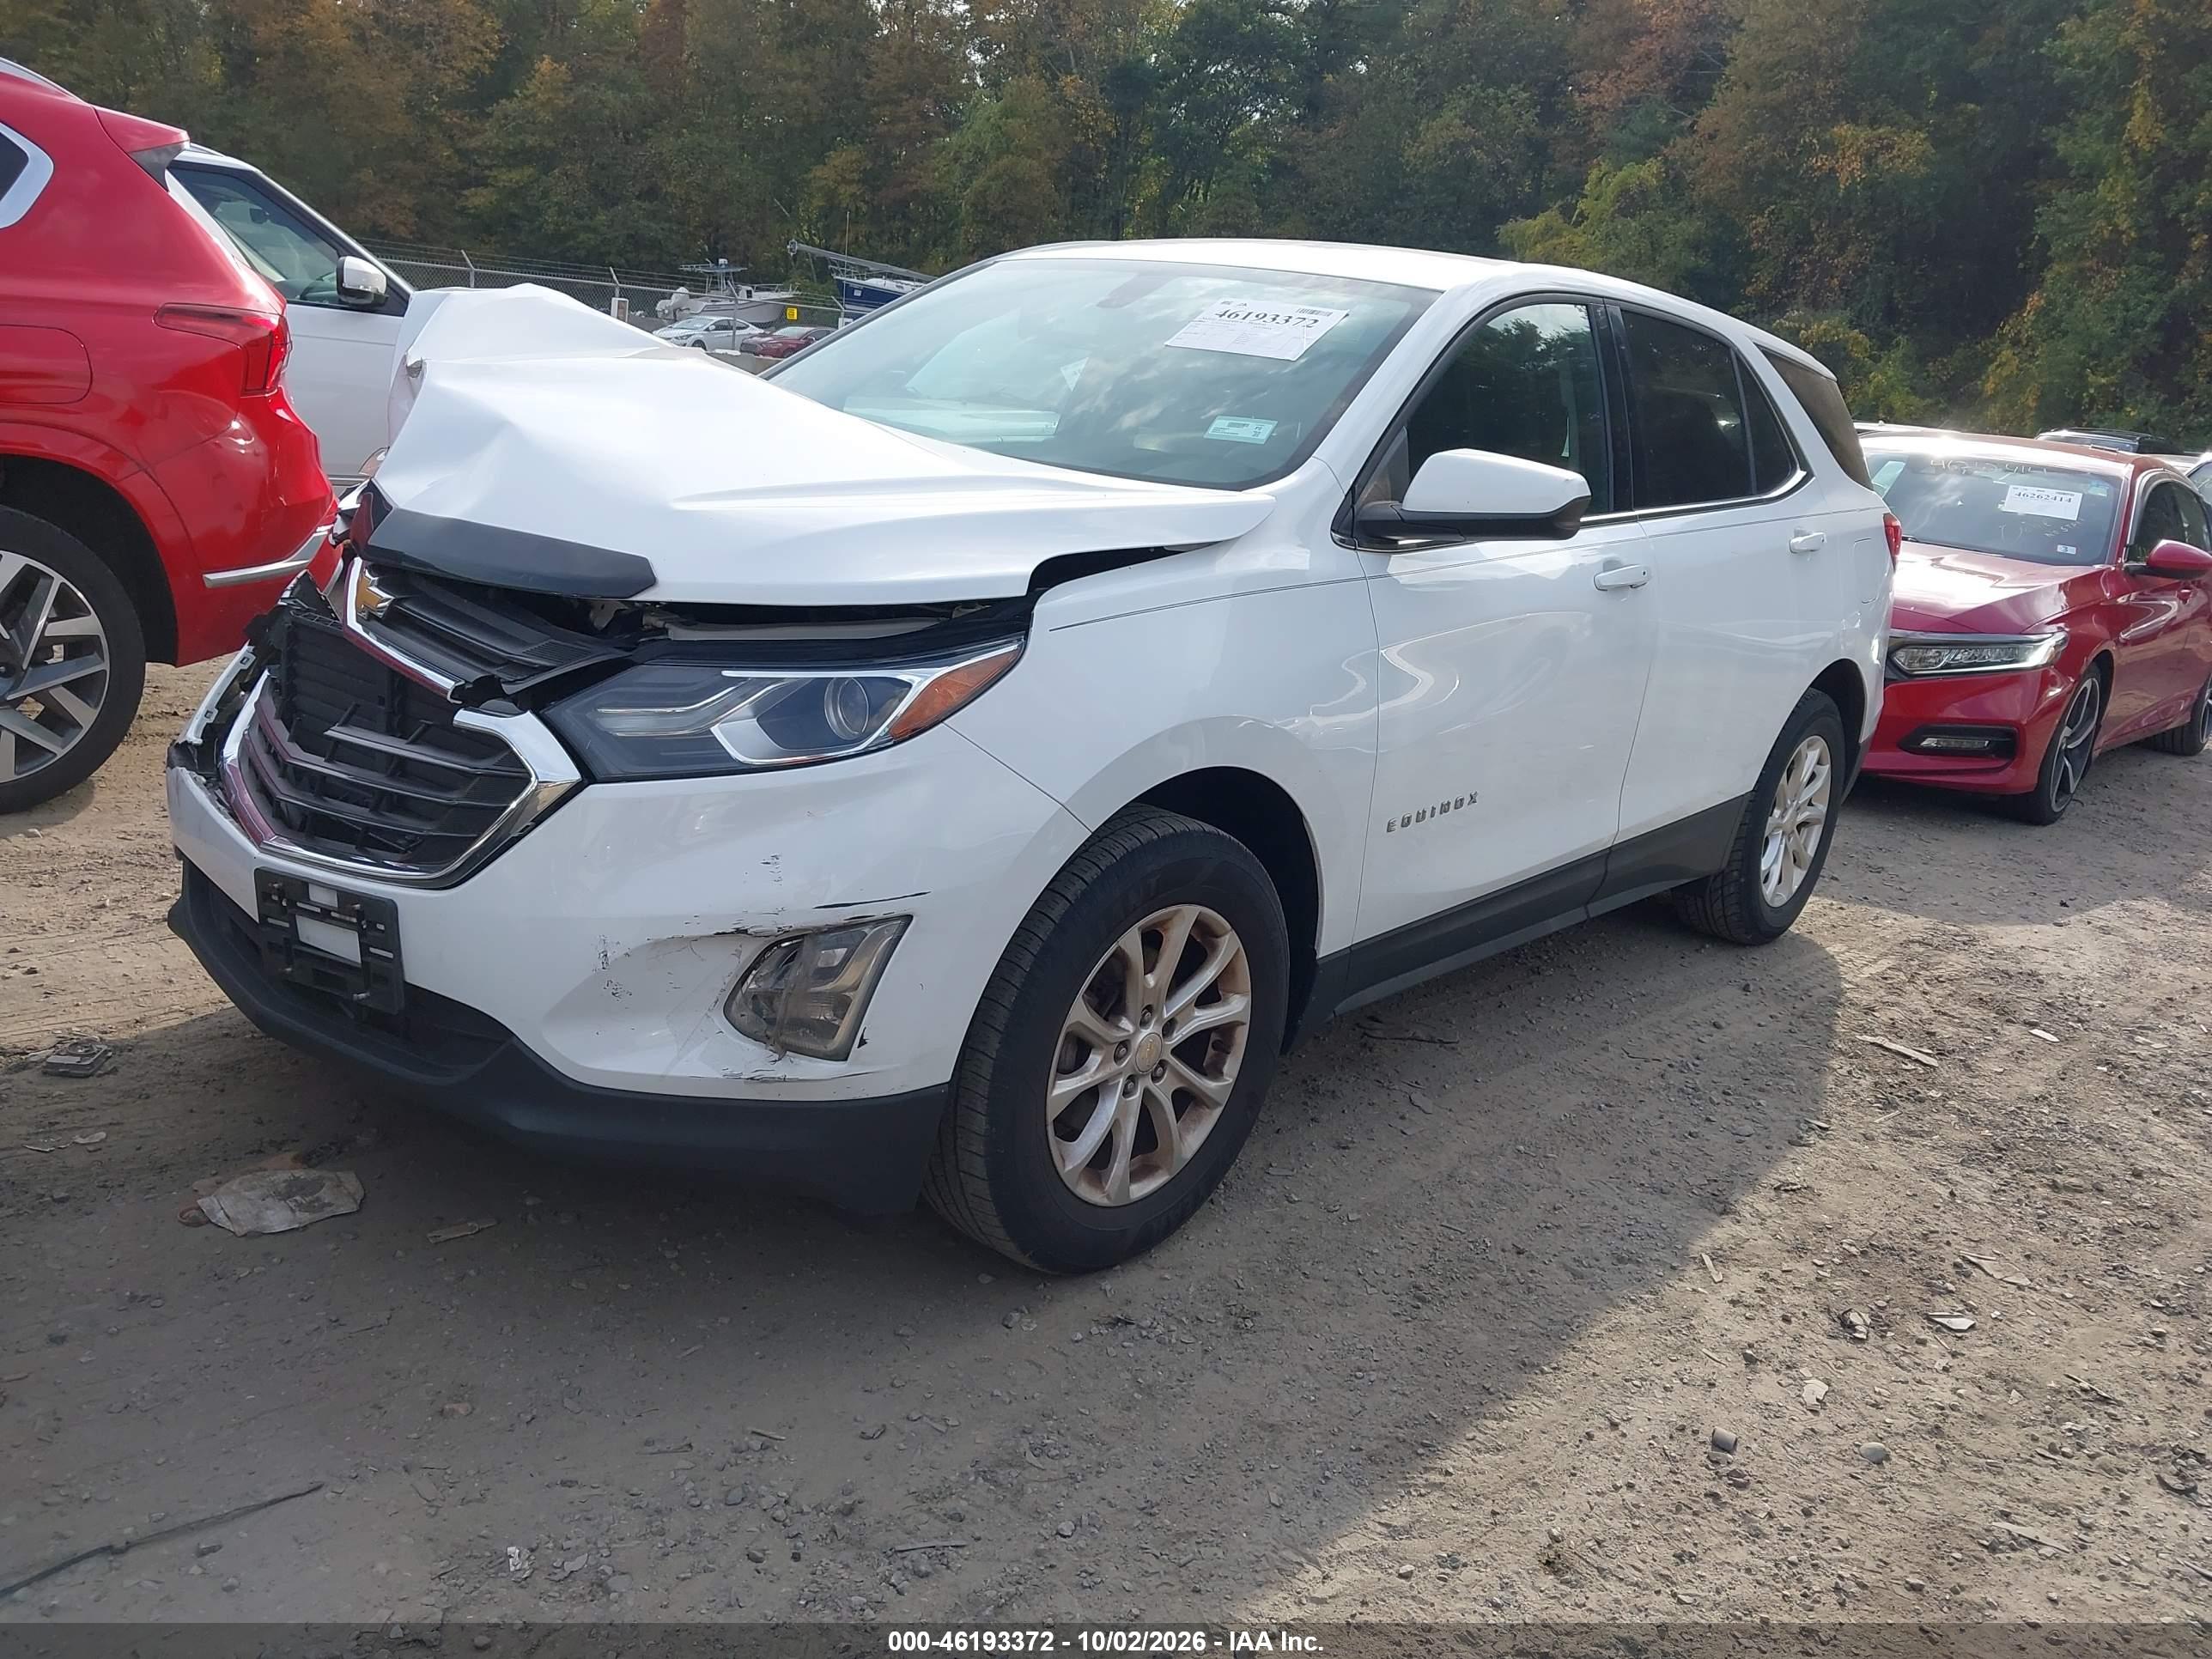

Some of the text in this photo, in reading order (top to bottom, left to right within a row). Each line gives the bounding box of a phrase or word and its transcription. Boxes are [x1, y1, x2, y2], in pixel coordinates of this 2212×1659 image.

[1215, 309, 1320, 328] 46193372
[2014, 491, 2073, 503] 46262414
[1386, 791, 1479, 833] EQUINOX
